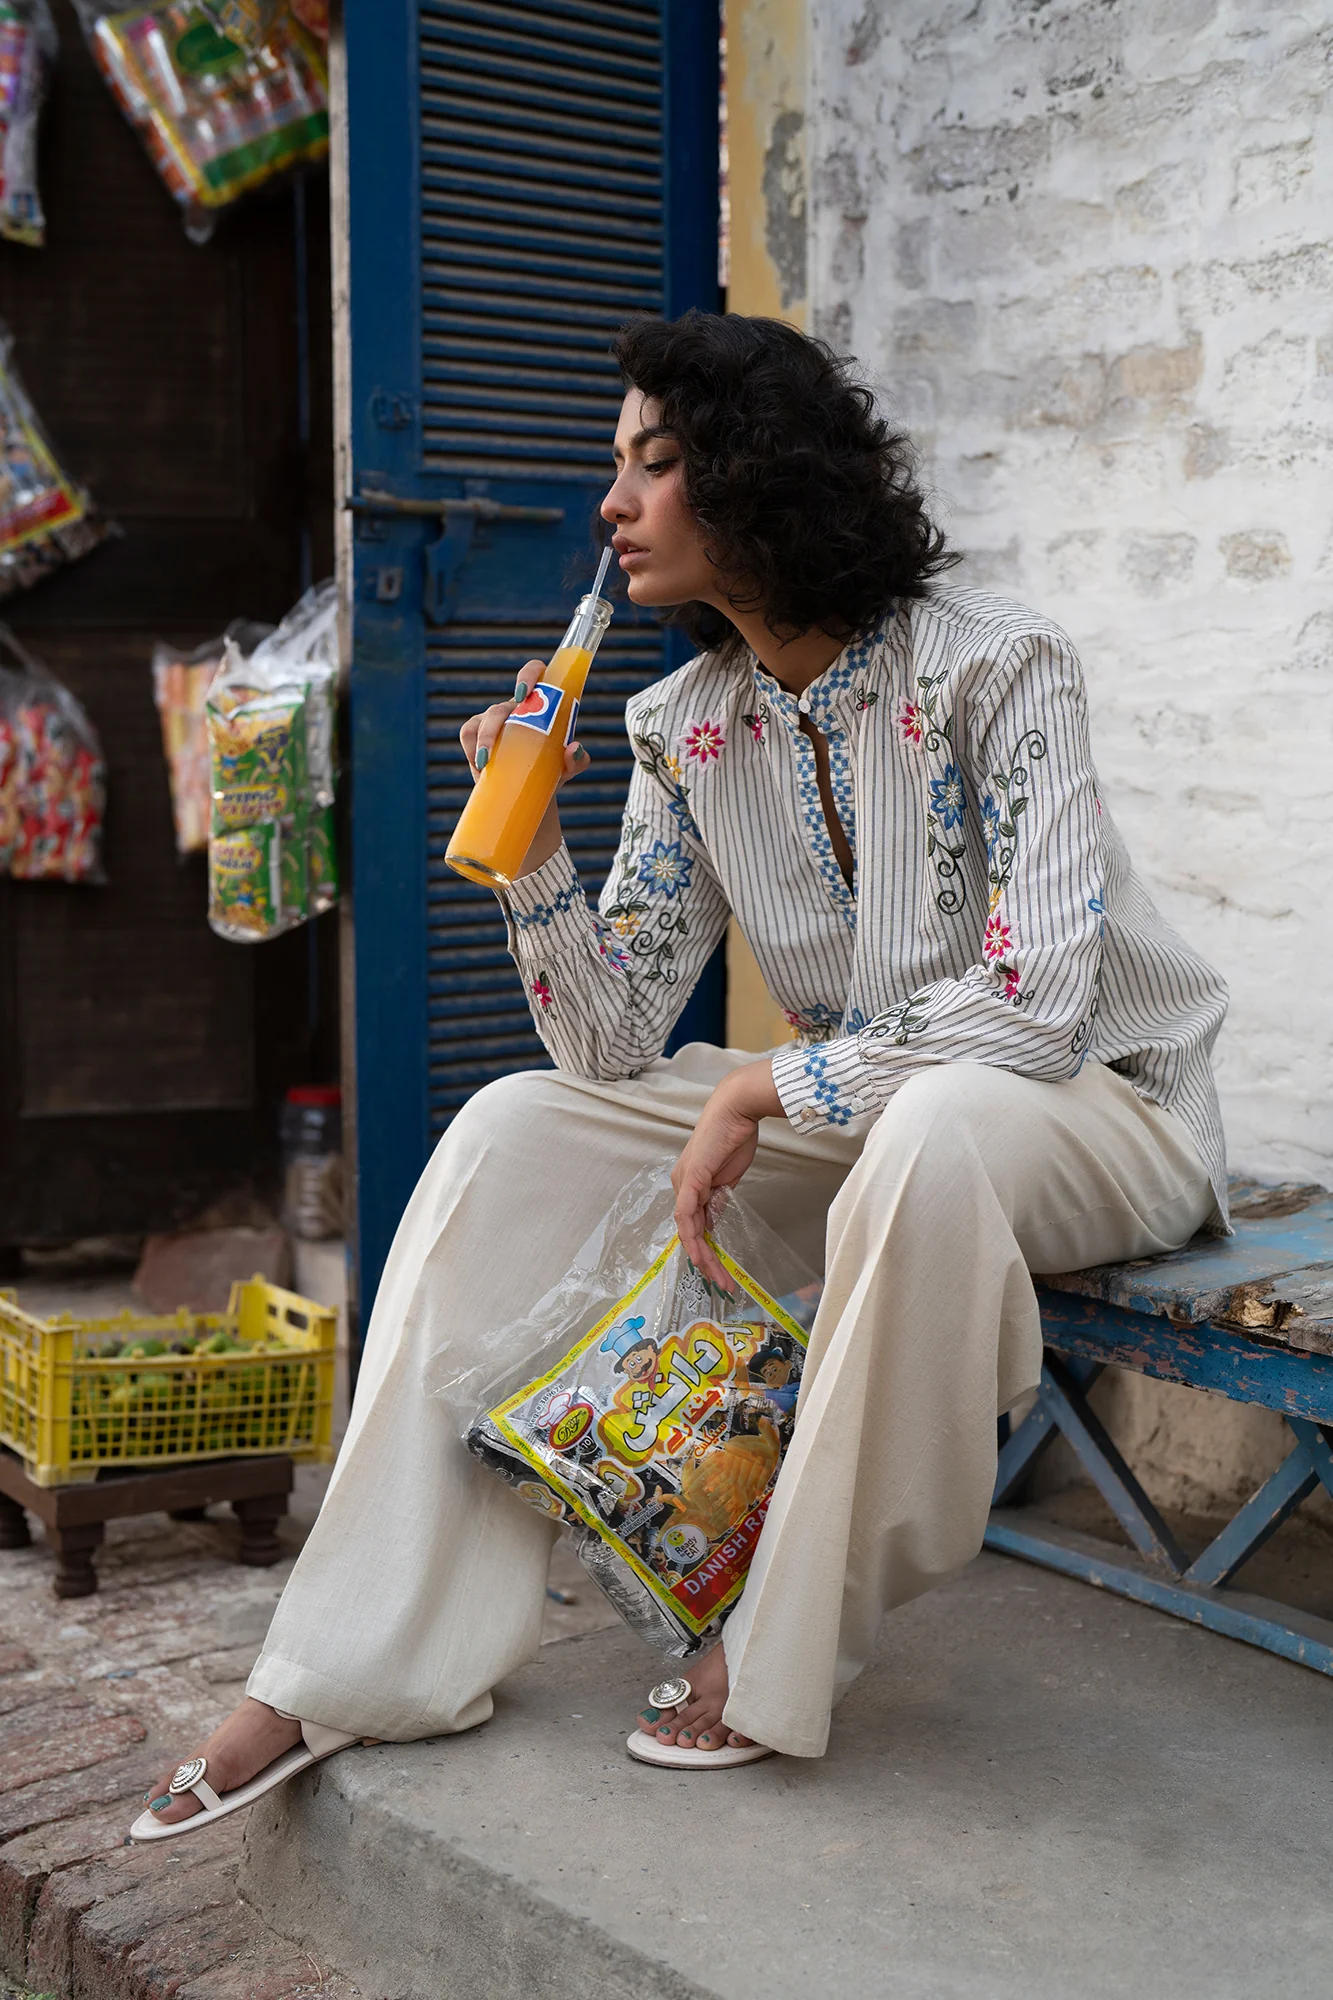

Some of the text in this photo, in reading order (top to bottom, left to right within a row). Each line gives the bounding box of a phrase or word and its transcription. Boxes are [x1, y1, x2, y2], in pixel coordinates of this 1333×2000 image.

[623, 1340, 723, 1452] دانش
[666, 1388, 724, 1455] چٹخارے
[674, 1536, 698, 1554] Ready
[683, 1532, 749, 1596] DANISH
[684, 1544, 700, 1559] EAT
